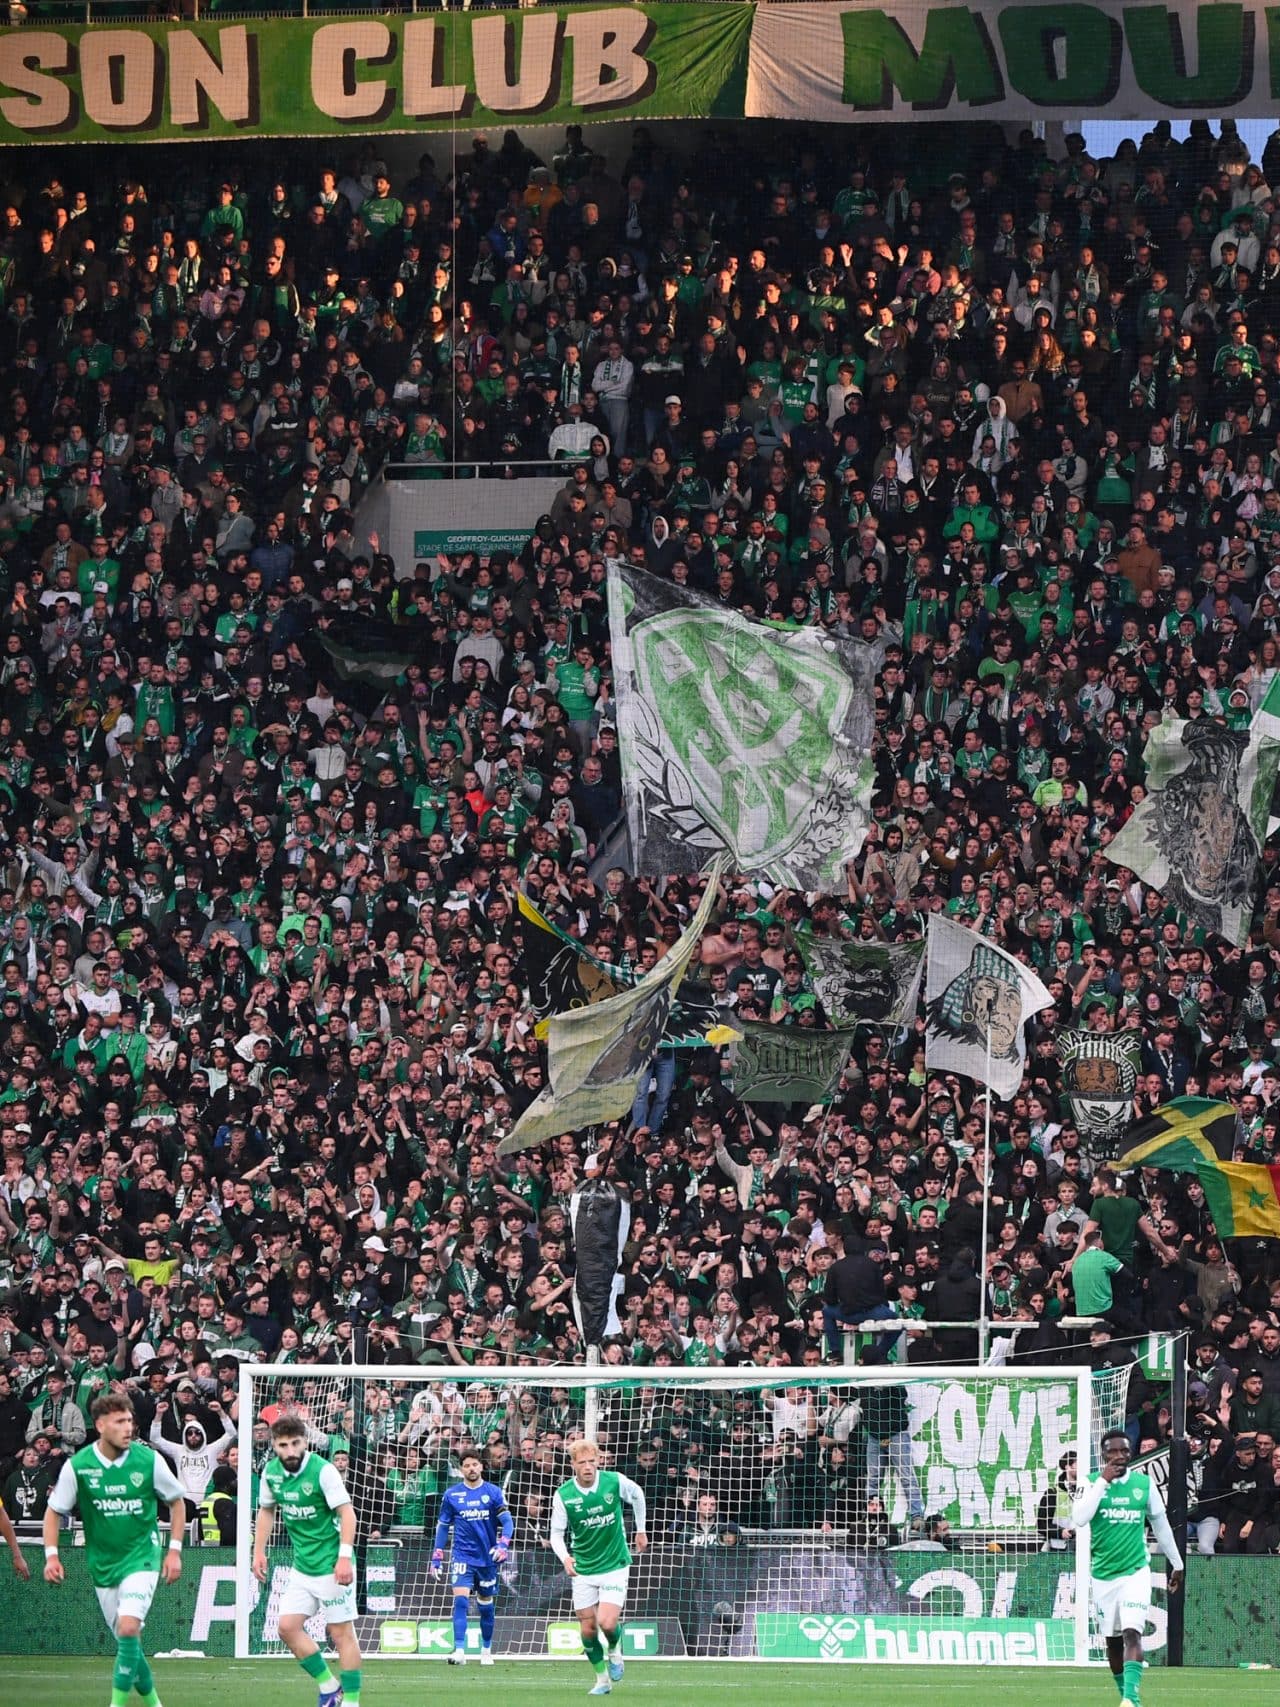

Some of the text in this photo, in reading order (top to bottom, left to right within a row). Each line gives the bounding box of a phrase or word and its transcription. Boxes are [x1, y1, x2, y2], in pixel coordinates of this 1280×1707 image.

[310, 8, 657, 126] CLUB
[417, 544, 441, 552] STADE
[447, 534, 532, 544] GEOFFROY-GUICHARD
[551, 1627, 655, 1650] BT
[864, 1618, 1048, 1661] hummel
